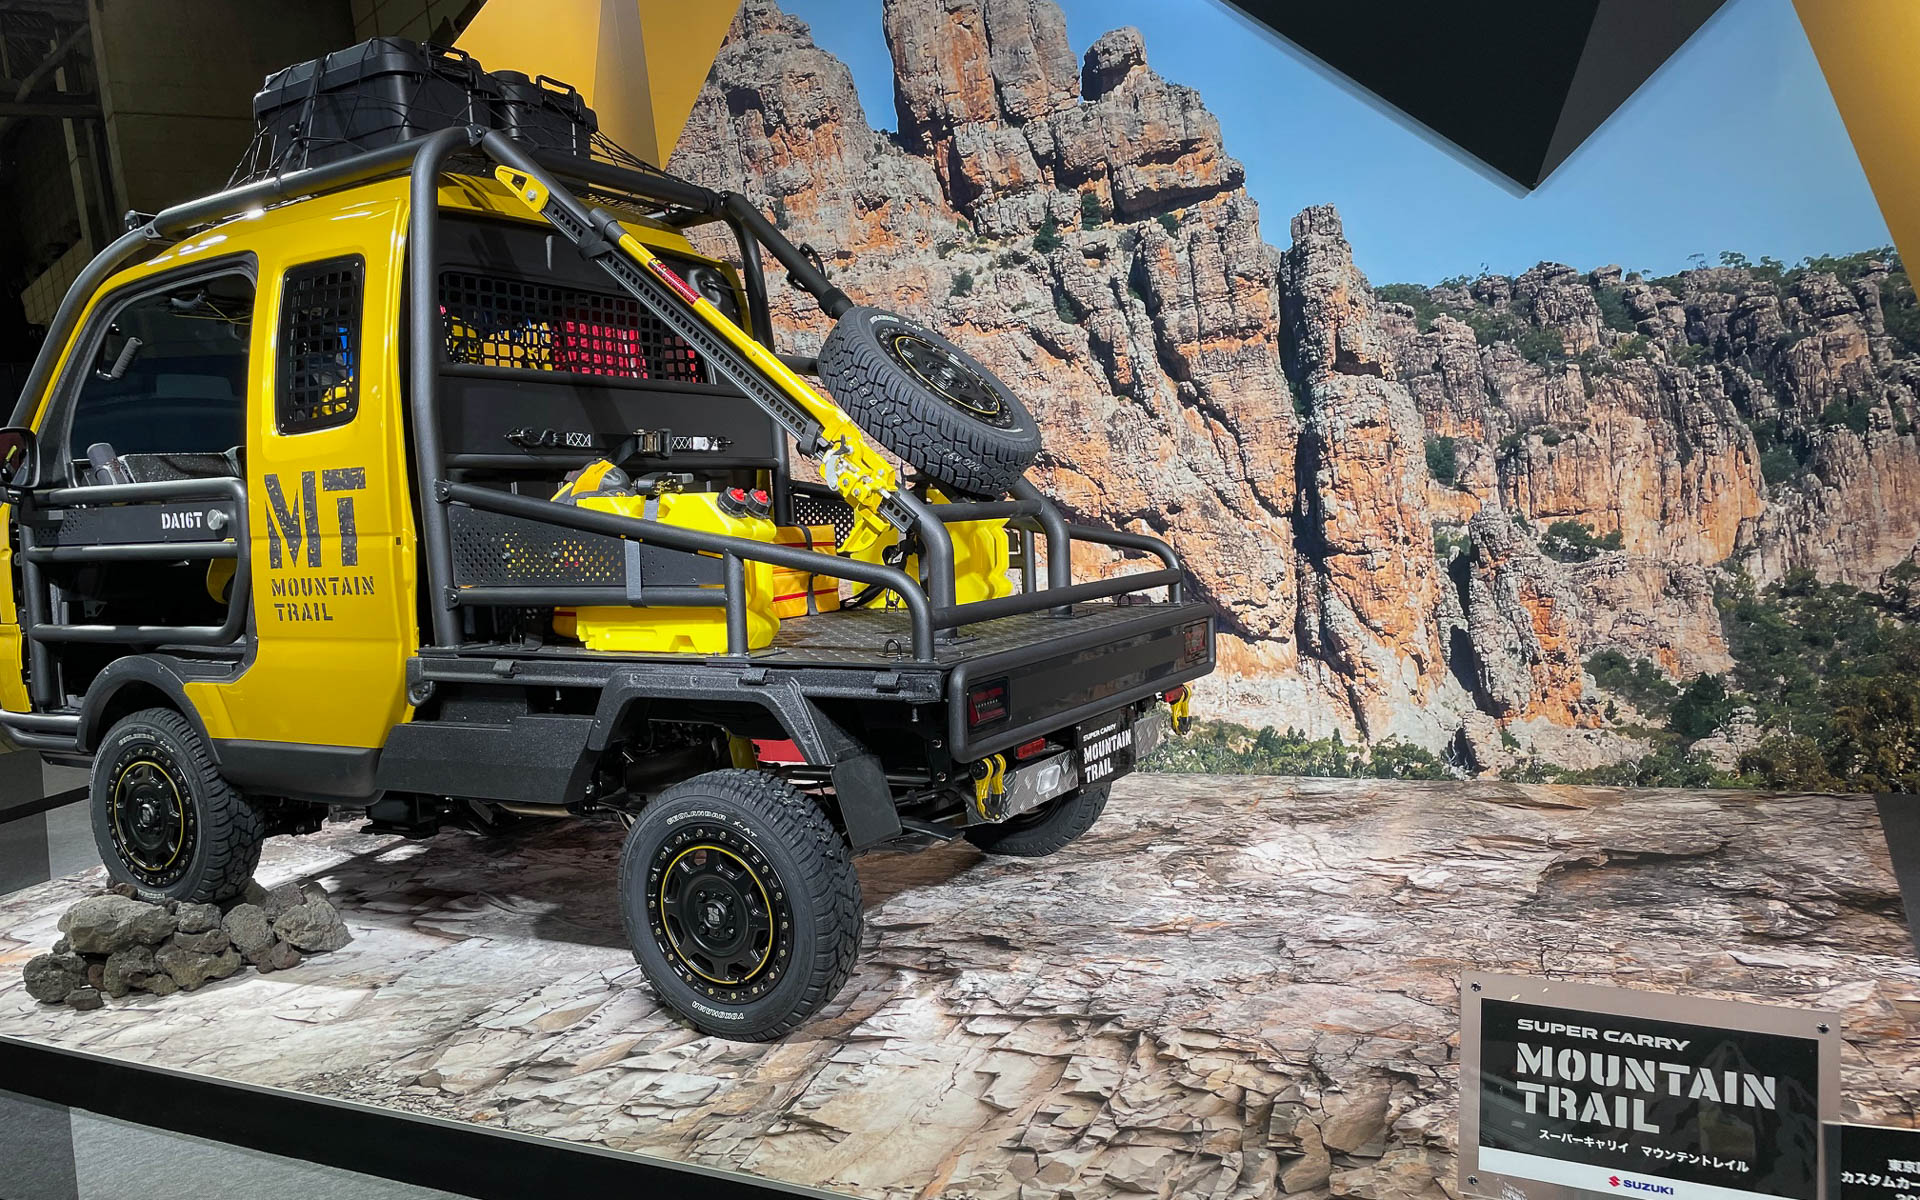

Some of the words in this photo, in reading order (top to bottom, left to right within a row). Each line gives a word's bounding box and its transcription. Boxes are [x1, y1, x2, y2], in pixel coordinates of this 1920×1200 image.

[161, 511, 203, 530] DA16T
[264, 467, 366, 569] MT
[271, 576, 375, 597] MOUNTAIN
[274, 602, 334, 622] TRAIL
[1083, 729, 1132, 764] MOUNTAIN
[1084, 757, 1114, 784] TRAIL
[1517, 1018, 1599, 1040] SUPER
[1603, 1030, 1691, 1051] CARRY
[1516, 1042, 1776, 1111] MOUNTAIN
[1516, 1080, 1660, 1134] TRAIL
[1539, 1129, 1630, 1154] スーパーキャリイ
[1641, 1145, 1750, 1173] マウンテントレイル
[1623, 1179, 1674, 1196] SUZUKI
